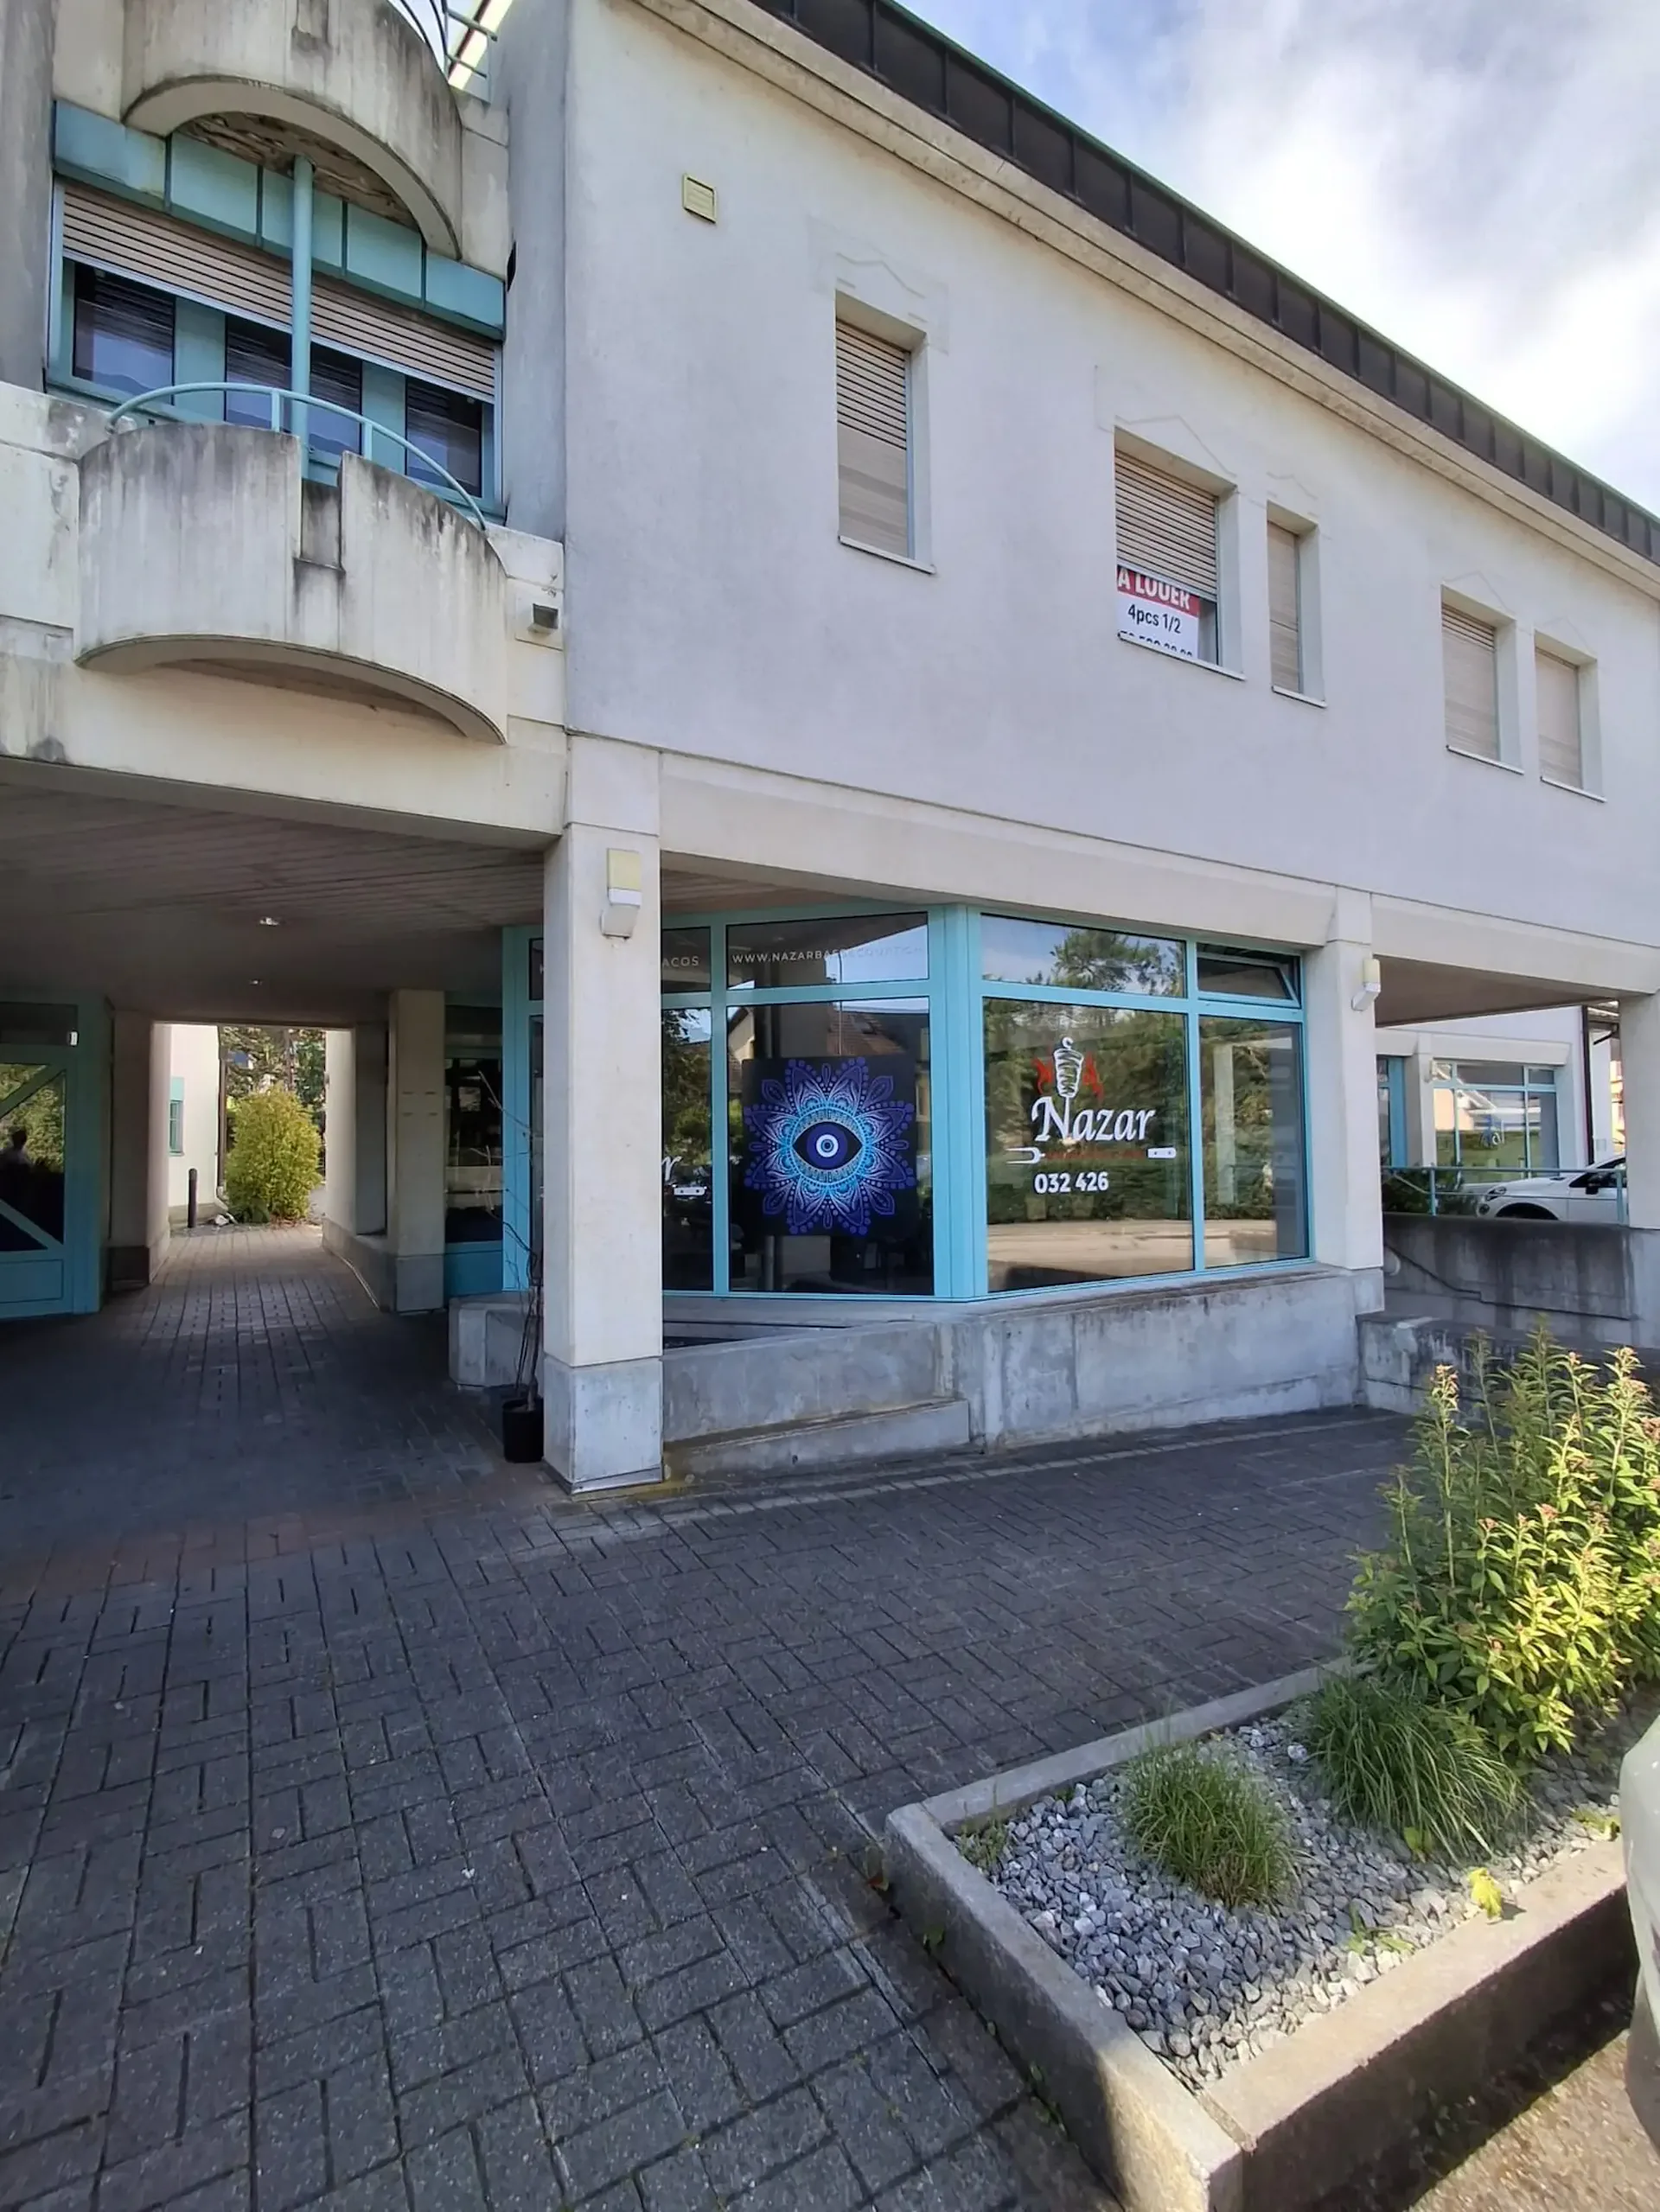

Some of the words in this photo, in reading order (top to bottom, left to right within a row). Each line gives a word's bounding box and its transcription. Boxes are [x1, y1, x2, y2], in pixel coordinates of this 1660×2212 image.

[1118, 569, 1131, 590] A
[1135, 574, 1191, 609] LOUER
[1127, 603, 1160, 626] 4pcs
[1162, 614, 1182, 634] 1/2
[661, 955, 700, 968] ACOS
[1031, 1095, 1157, 1142] Nazar
[1034, 1172, 1071, 1194] 032
[1075, 1171, 1109, 1192] 426
